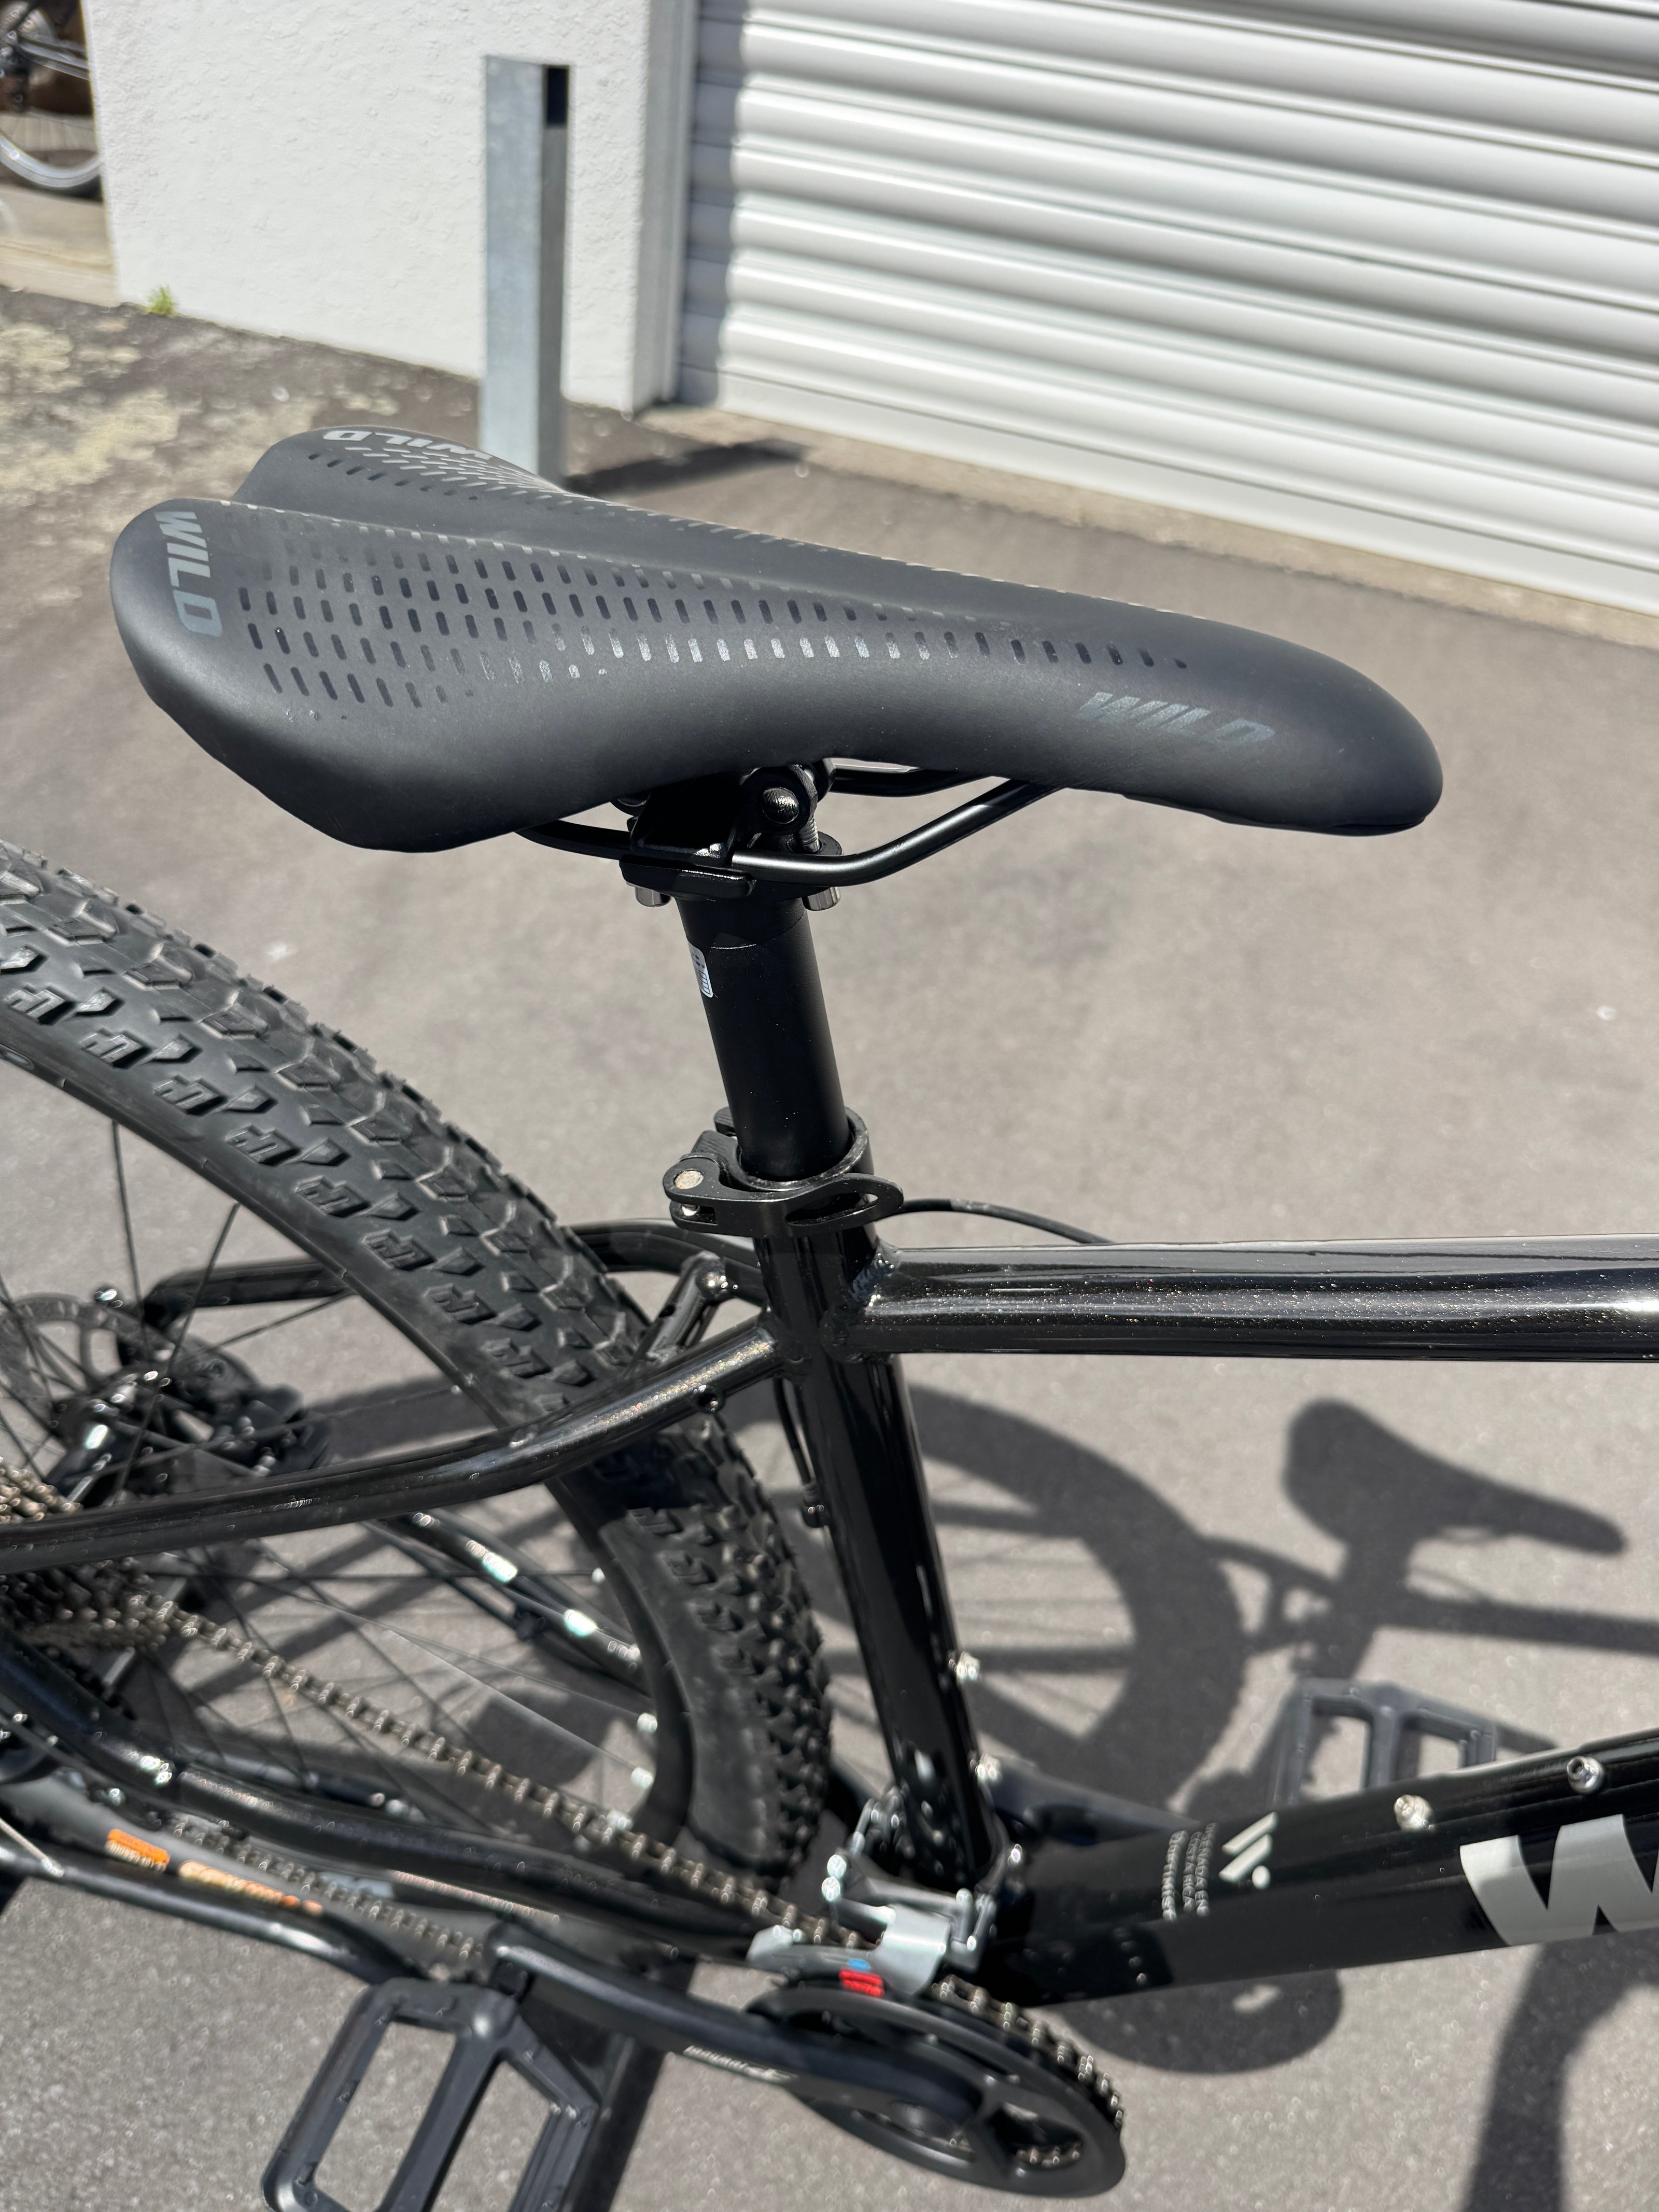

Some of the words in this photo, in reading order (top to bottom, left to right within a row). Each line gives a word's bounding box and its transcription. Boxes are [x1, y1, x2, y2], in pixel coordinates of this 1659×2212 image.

[323, 430, 493, 460] WILD
[154, 511, 223, 637] WILD
[1075, 691, 1275, 742] WILD
